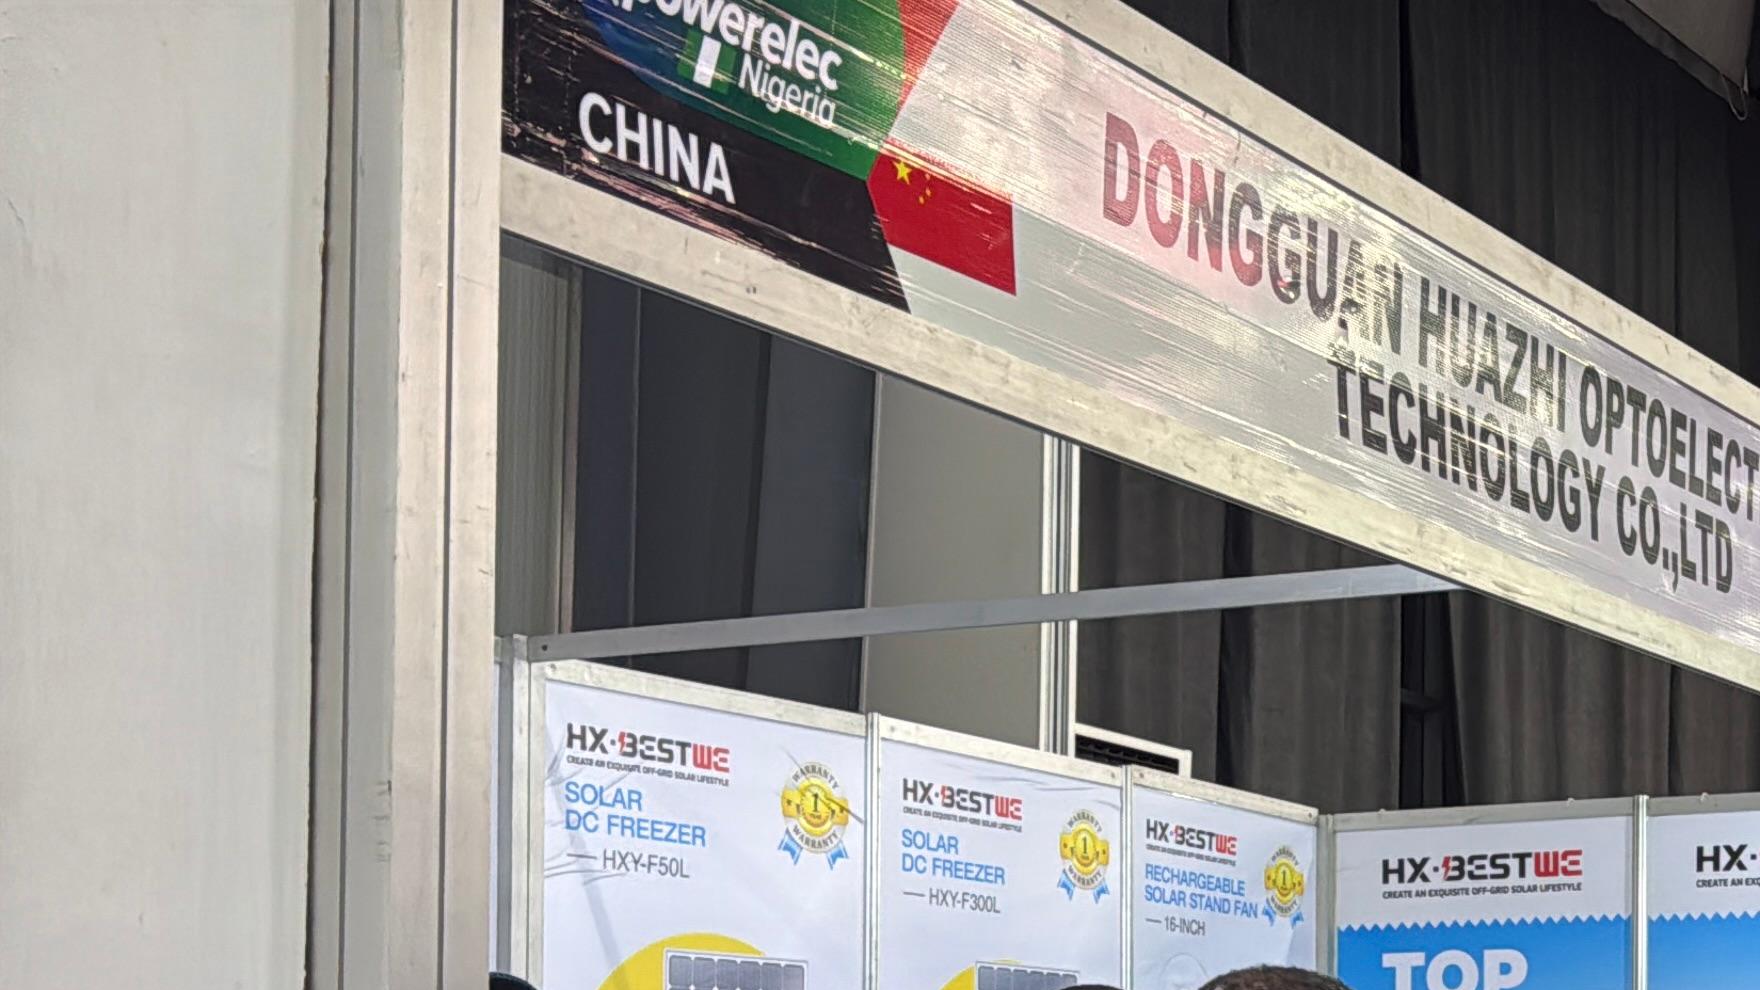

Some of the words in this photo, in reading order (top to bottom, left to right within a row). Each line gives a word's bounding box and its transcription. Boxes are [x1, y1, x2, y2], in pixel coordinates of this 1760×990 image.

[622, 0, 842, 91] werelec
[738, 53, 836, 125] Nigeria
[580, 92, 735, 204] CHINA
[1103, 112, 1403, 355] DONGGUAN
[1418, 276, 1566, 433] HUAZHI
[1327, 347, 1605, 541] TECHNOLOGY
[565, 781, 642, 812] SOLAR
[565, 809, 599, 833] DC
[607, 814, 706, 848] FREEZER
[901, 829, 959, 855] SOLAR
[603, 850, 690, 879] HXY-F50L
[901, 853, 927, 874] DC
[932, 856, 1006, 886] FREEZER
[1145, 863, 1246, 897] RECHARGEABLE
[1383, 889, 1412, 900] CREATE
[1414, 888, 1427, 898] AN
[1428, 887, 1470, 899] EXQUISITE
[1472, 885, 1509, 896] OFF-GRID
[1511, 884, 1538, 894] SOLAR
[1540, 882, 1582, 892] LIFESTYLE
[1696, 878, 1728, 888] CREATE
[1730, 878, 1743, 887] AN
[928, 887, 1000, 914] HXY-F300L
[1144, 884, 1186, 907] SOLAR
[1189, 892, 1231, 914] STAND
[1234, 900, 1258, 919] FAN
[1164, 916, 1206, 936] 16-INCH
